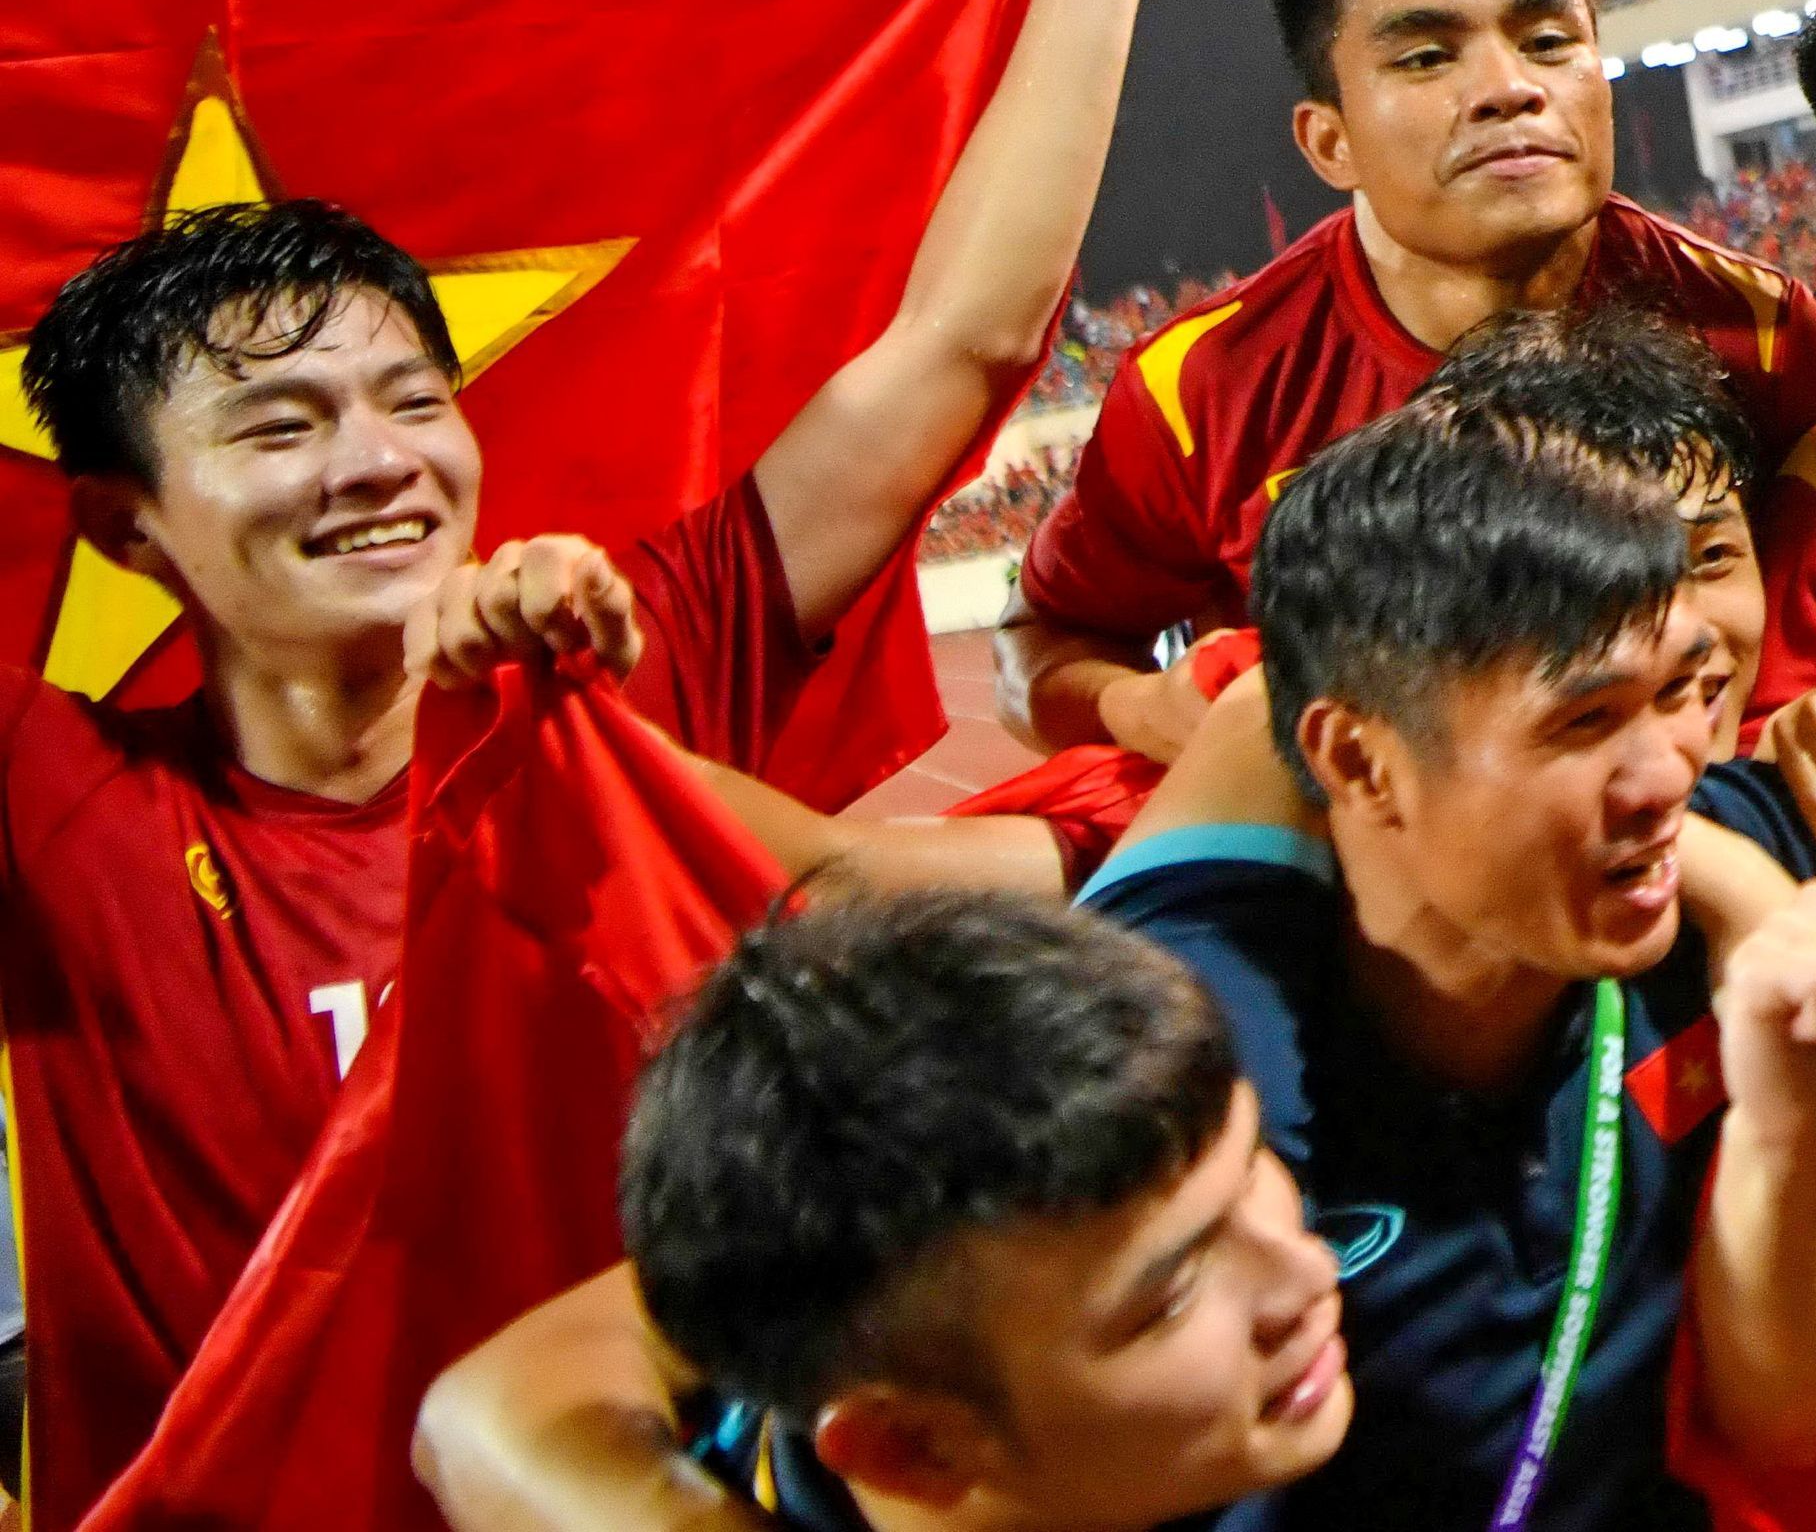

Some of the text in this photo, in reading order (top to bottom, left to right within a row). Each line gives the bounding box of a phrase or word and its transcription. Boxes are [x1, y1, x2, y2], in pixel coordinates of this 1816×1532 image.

[309, 979, 395, 1082] 1
[1598, 1034, 1624, 1096] FOR
[1597, 1101, 1620, 1123] A
[1575, 1128, 1618, 1289] STRONGER
[1500, 1459, 1538, 1526] ASIA
